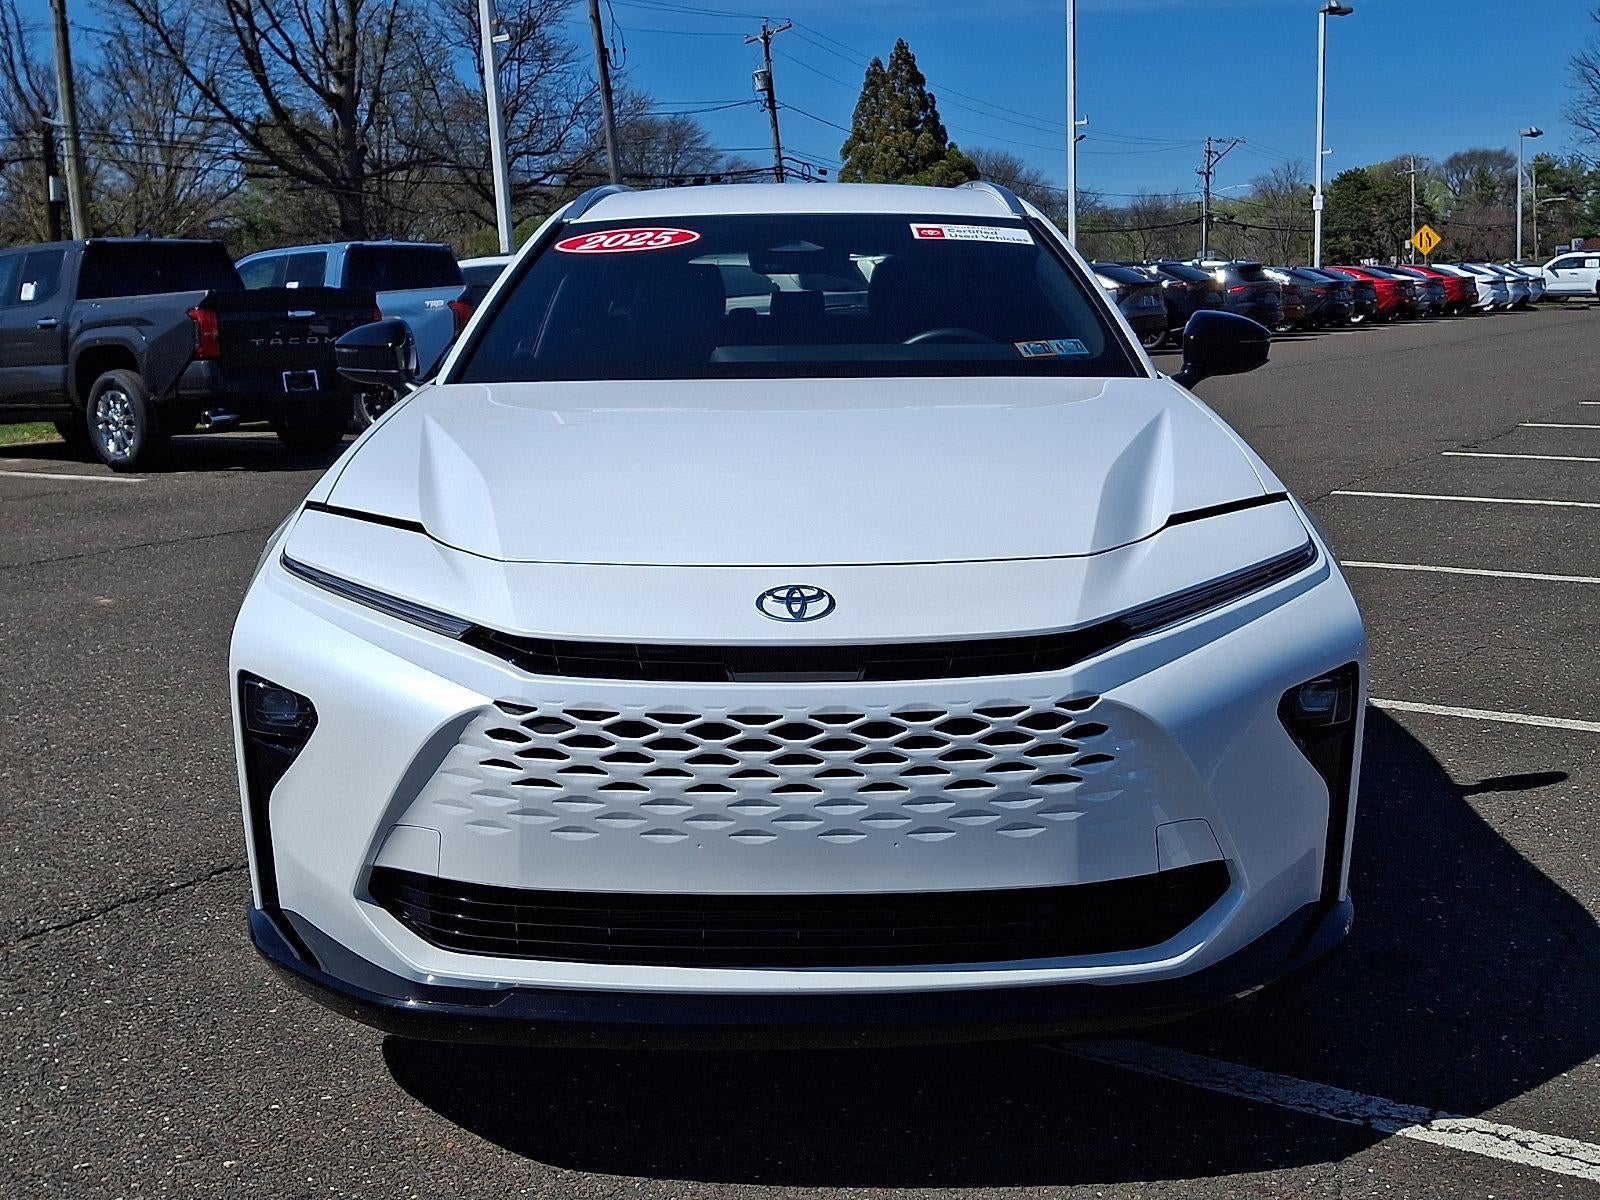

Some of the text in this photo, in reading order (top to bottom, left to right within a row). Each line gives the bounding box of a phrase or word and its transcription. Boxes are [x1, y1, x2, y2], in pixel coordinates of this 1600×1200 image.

[576, 231, 679, 250] 2025
[980, 234, 1029, 242] Vehicles
[425, 300, 444, 308] TRD
[250, 336, 338, 346] TACOM
